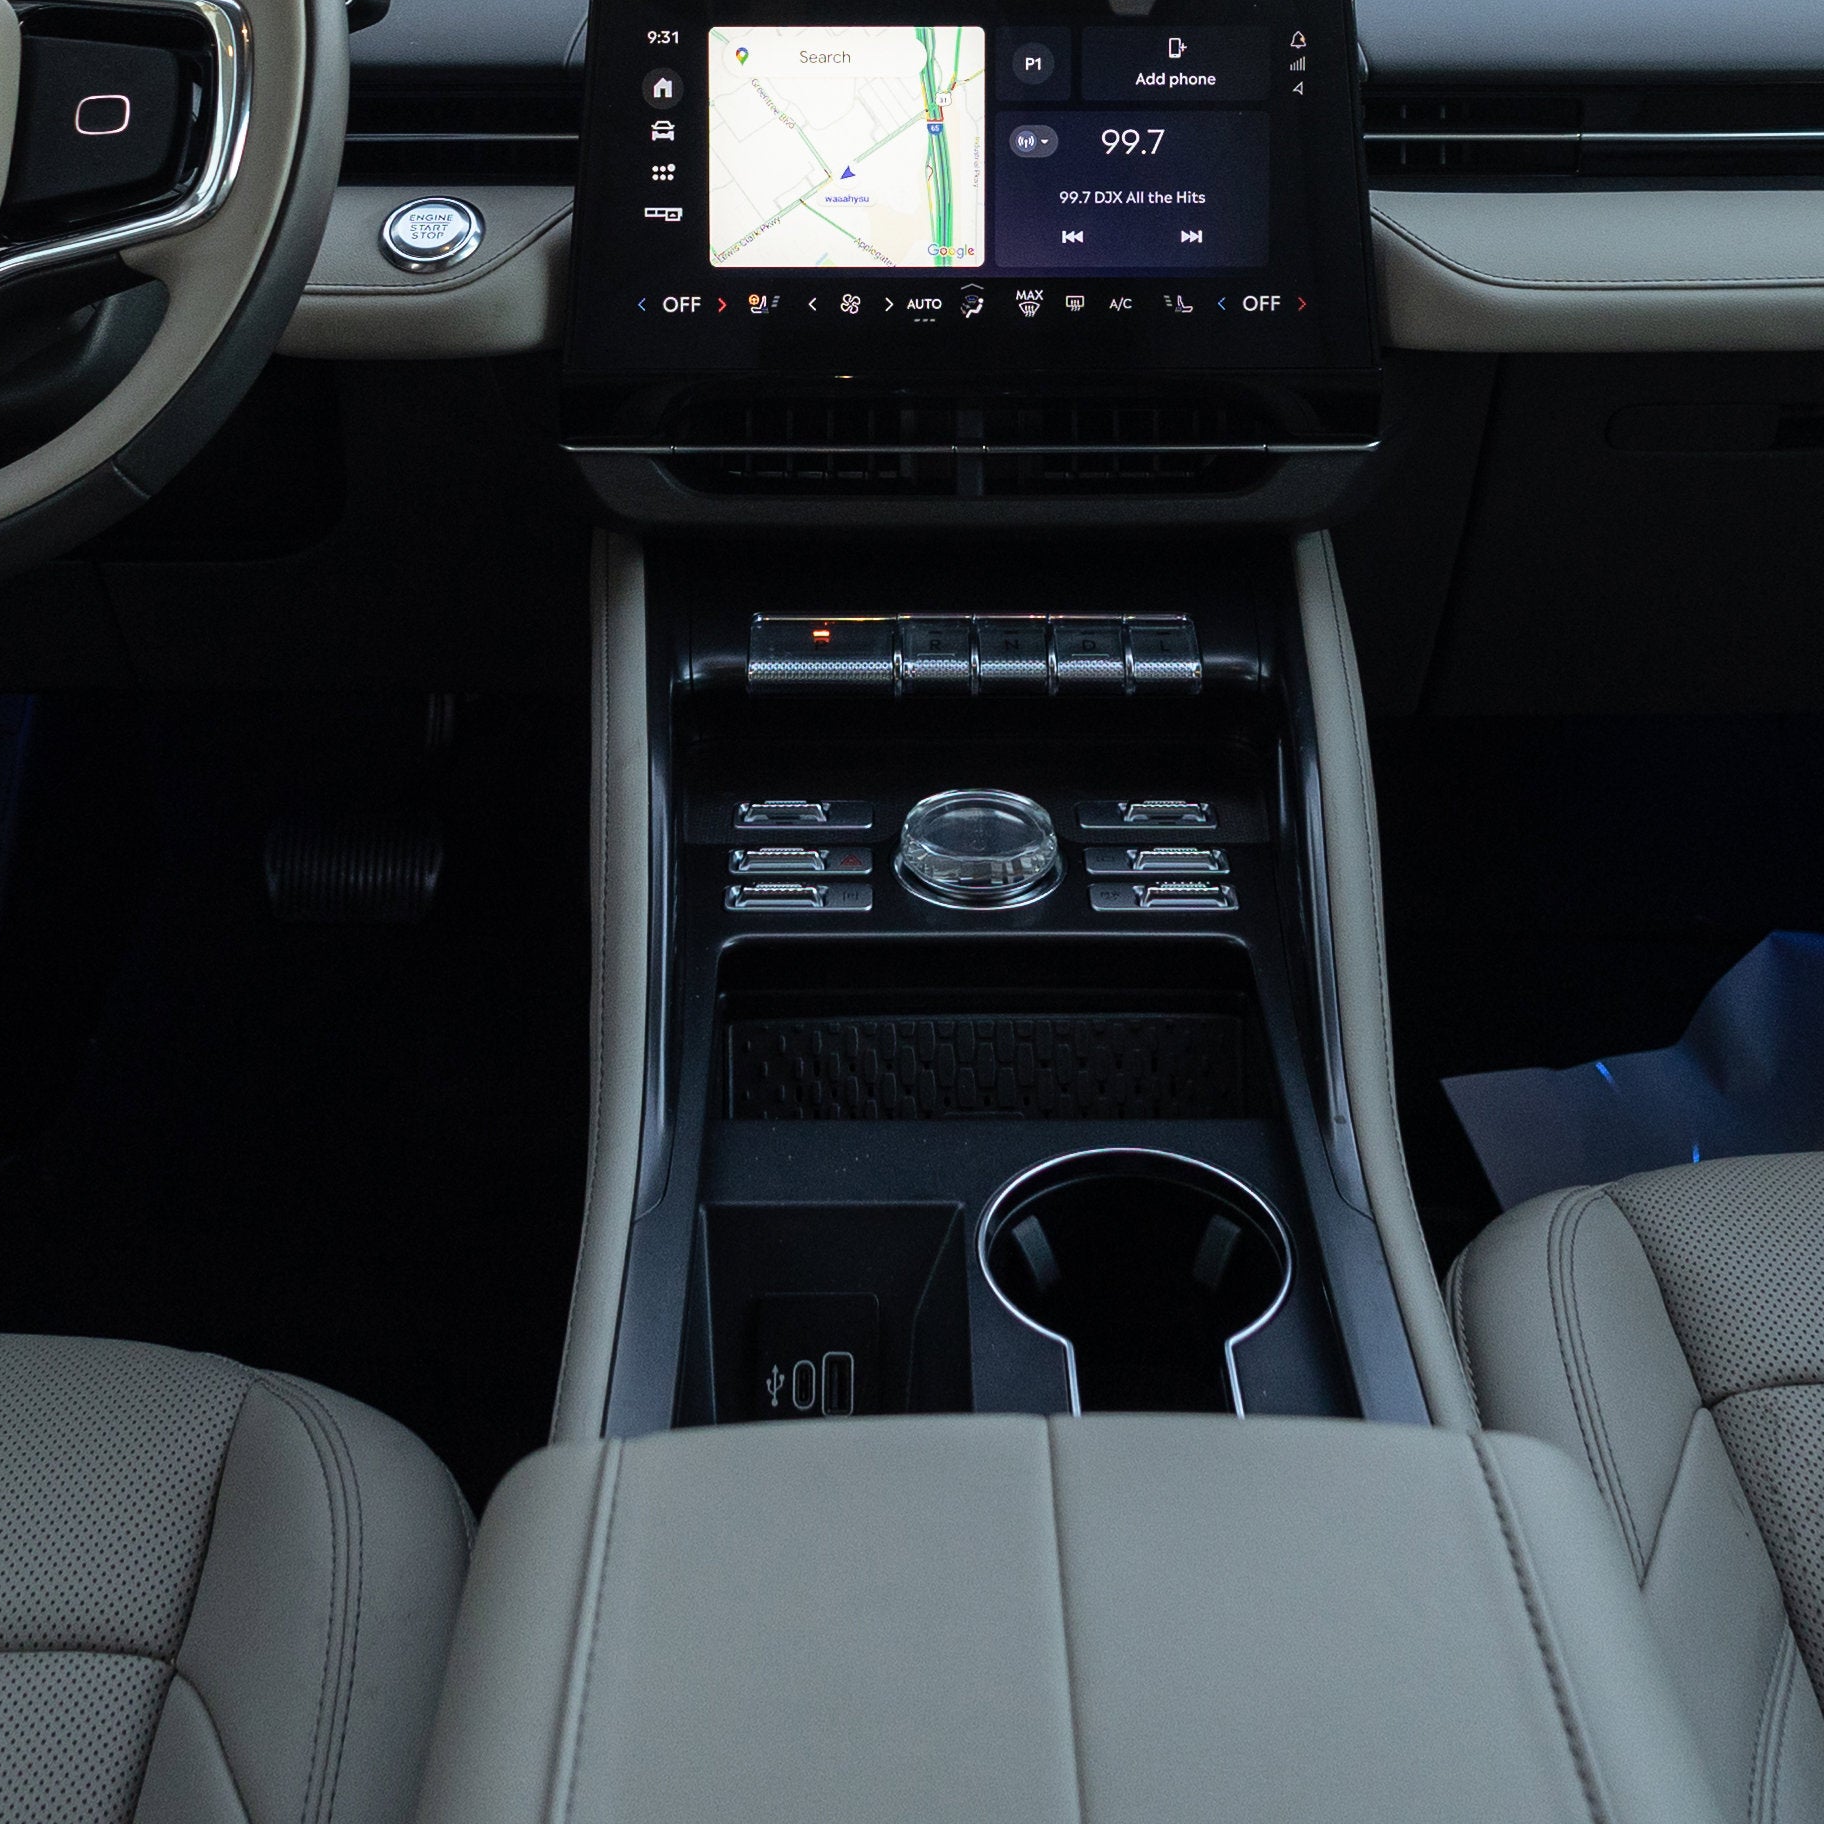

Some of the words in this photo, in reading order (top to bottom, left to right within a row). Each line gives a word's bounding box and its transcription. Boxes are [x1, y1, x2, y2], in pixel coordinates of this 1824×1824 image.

[648, 30, 679, 44] 9:31
[799, 50, 851, 64] Search
[1025, 57, 1042, 71] P1
[1135, 72, 1166, 86] Add
[1169, 72, 1216, 88] phone
[930, 124, 940, 132] 65
[1101, 128, 1165, 155] 99.7
[1059, 191, 1091, 204] 99.7
[1094, 191, 1123, 204] DJX
[1126, 191, 1144, 204] All
[1148, 191, 1173, 204] the
[1176, 191, 1206, 204] Hits
[409, 213, 454, 222] ENGINE
[410, 223, 449, 232] START
[411, 231, 445, 240] STOP
[927, 243, 975, 259] Google
[1016, 290, 1044, 301] MAX
[662, 296, 701, 313] OFF
[907, 298, 943, 310] AUTO
[1109, 297, 1133, 310] A/C
[1242, 295, 1281, 312] OFF
[930, 639, 942, 652] R
[1005, 639, 1019, 652] N
[1082, 639, 1097, 652] D
